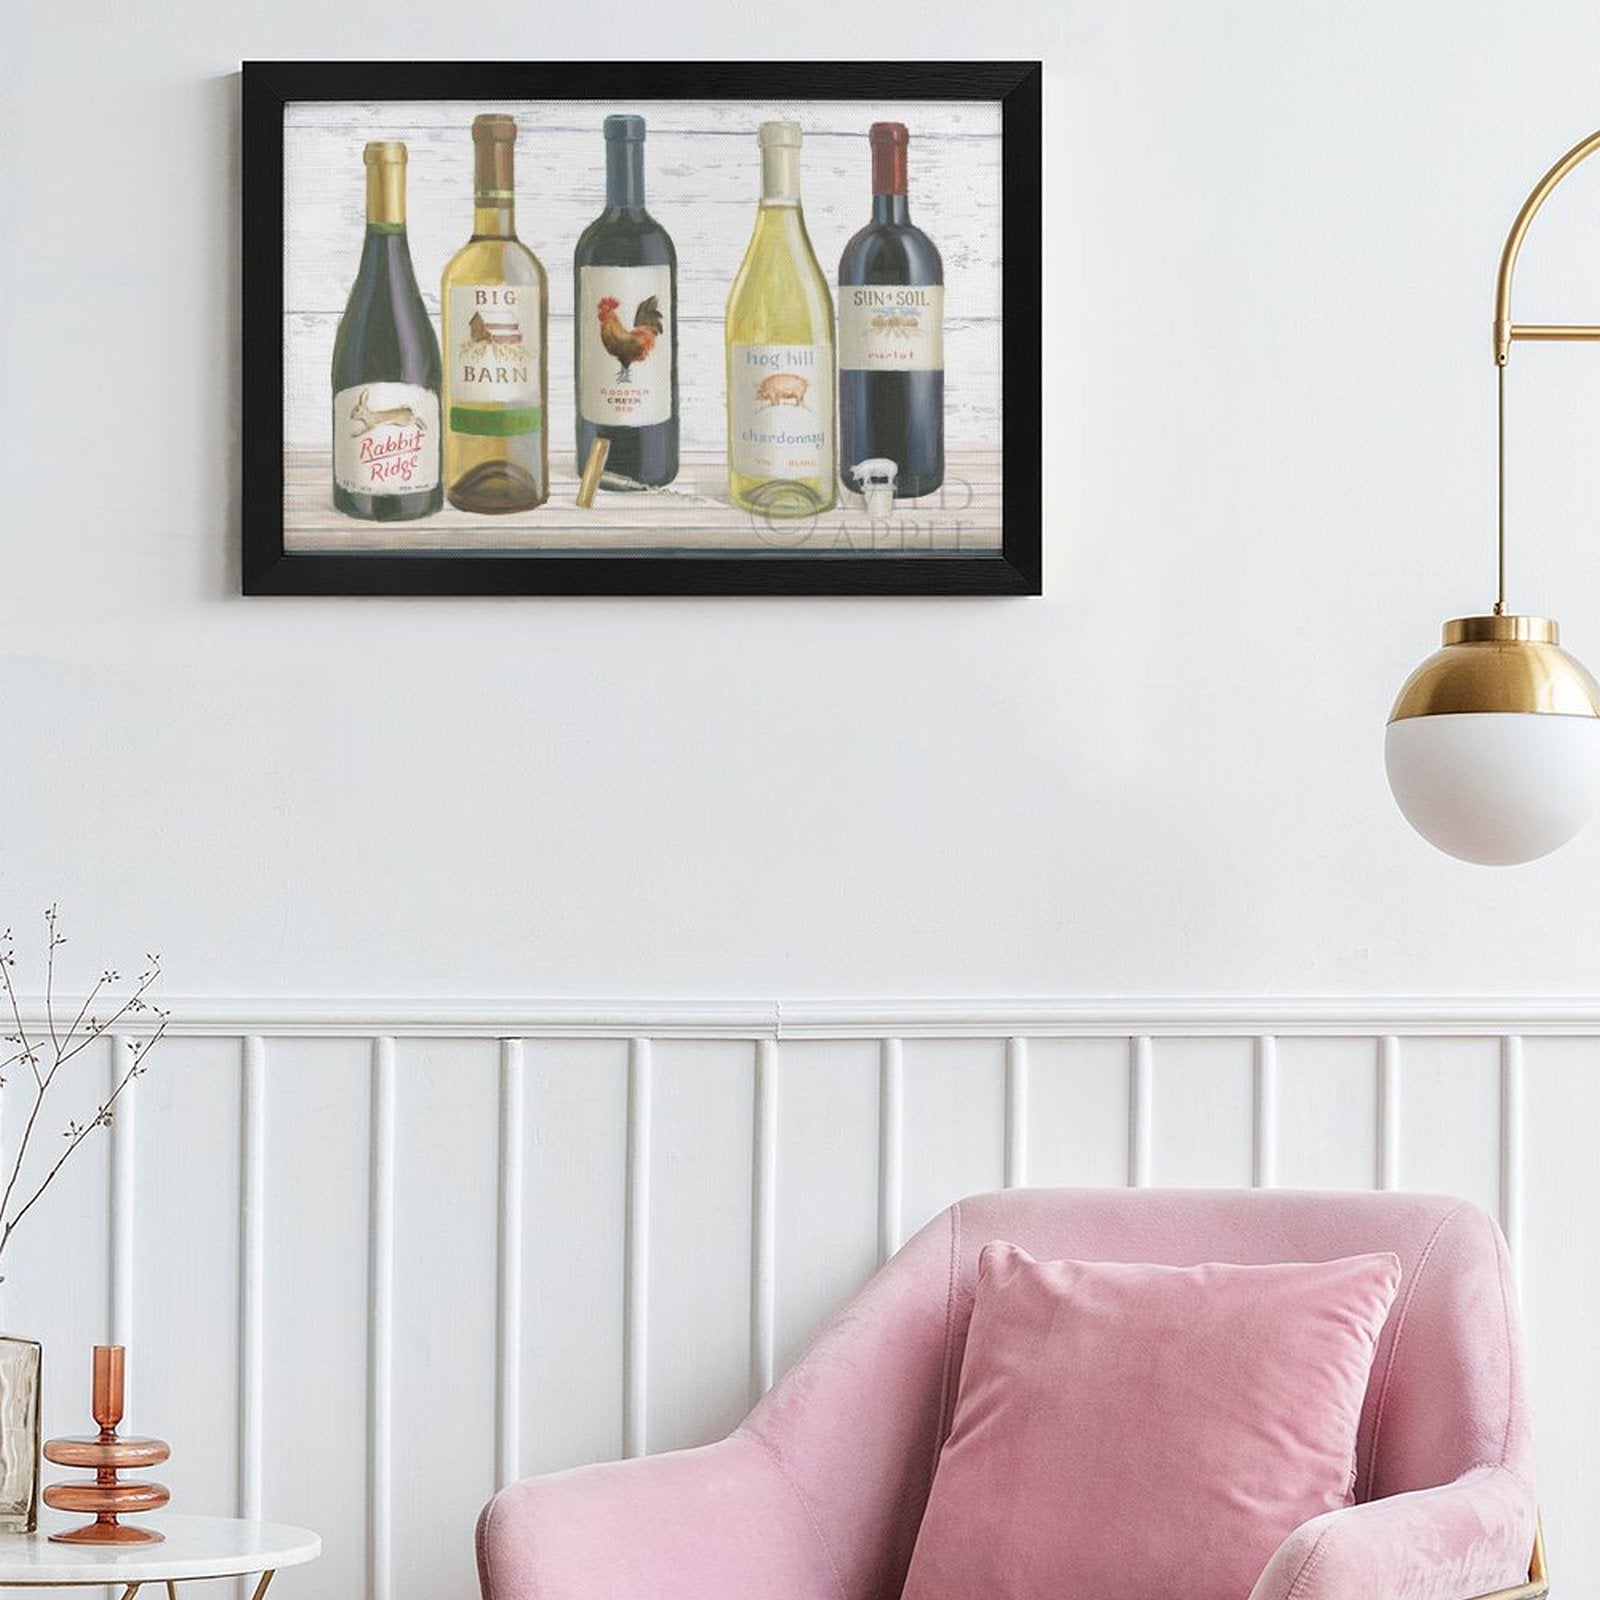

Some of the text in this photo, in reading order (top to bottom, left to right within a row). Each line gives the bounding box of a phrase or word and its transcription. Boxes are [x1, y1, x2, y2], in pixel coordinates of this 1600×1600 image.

[475, 290, 516, 305] BIG
[853, 290, 885, 306] SUN
[896, 291, 931, 306] SOIL
[746, 350, 814, 369] hog hill
[463, 366, 528, 383] BARN
[360, 430, 426, 459] Rabbit
[742, 429, 825, 449] chardonnay
[370, 456, 418, 482] Ridge
